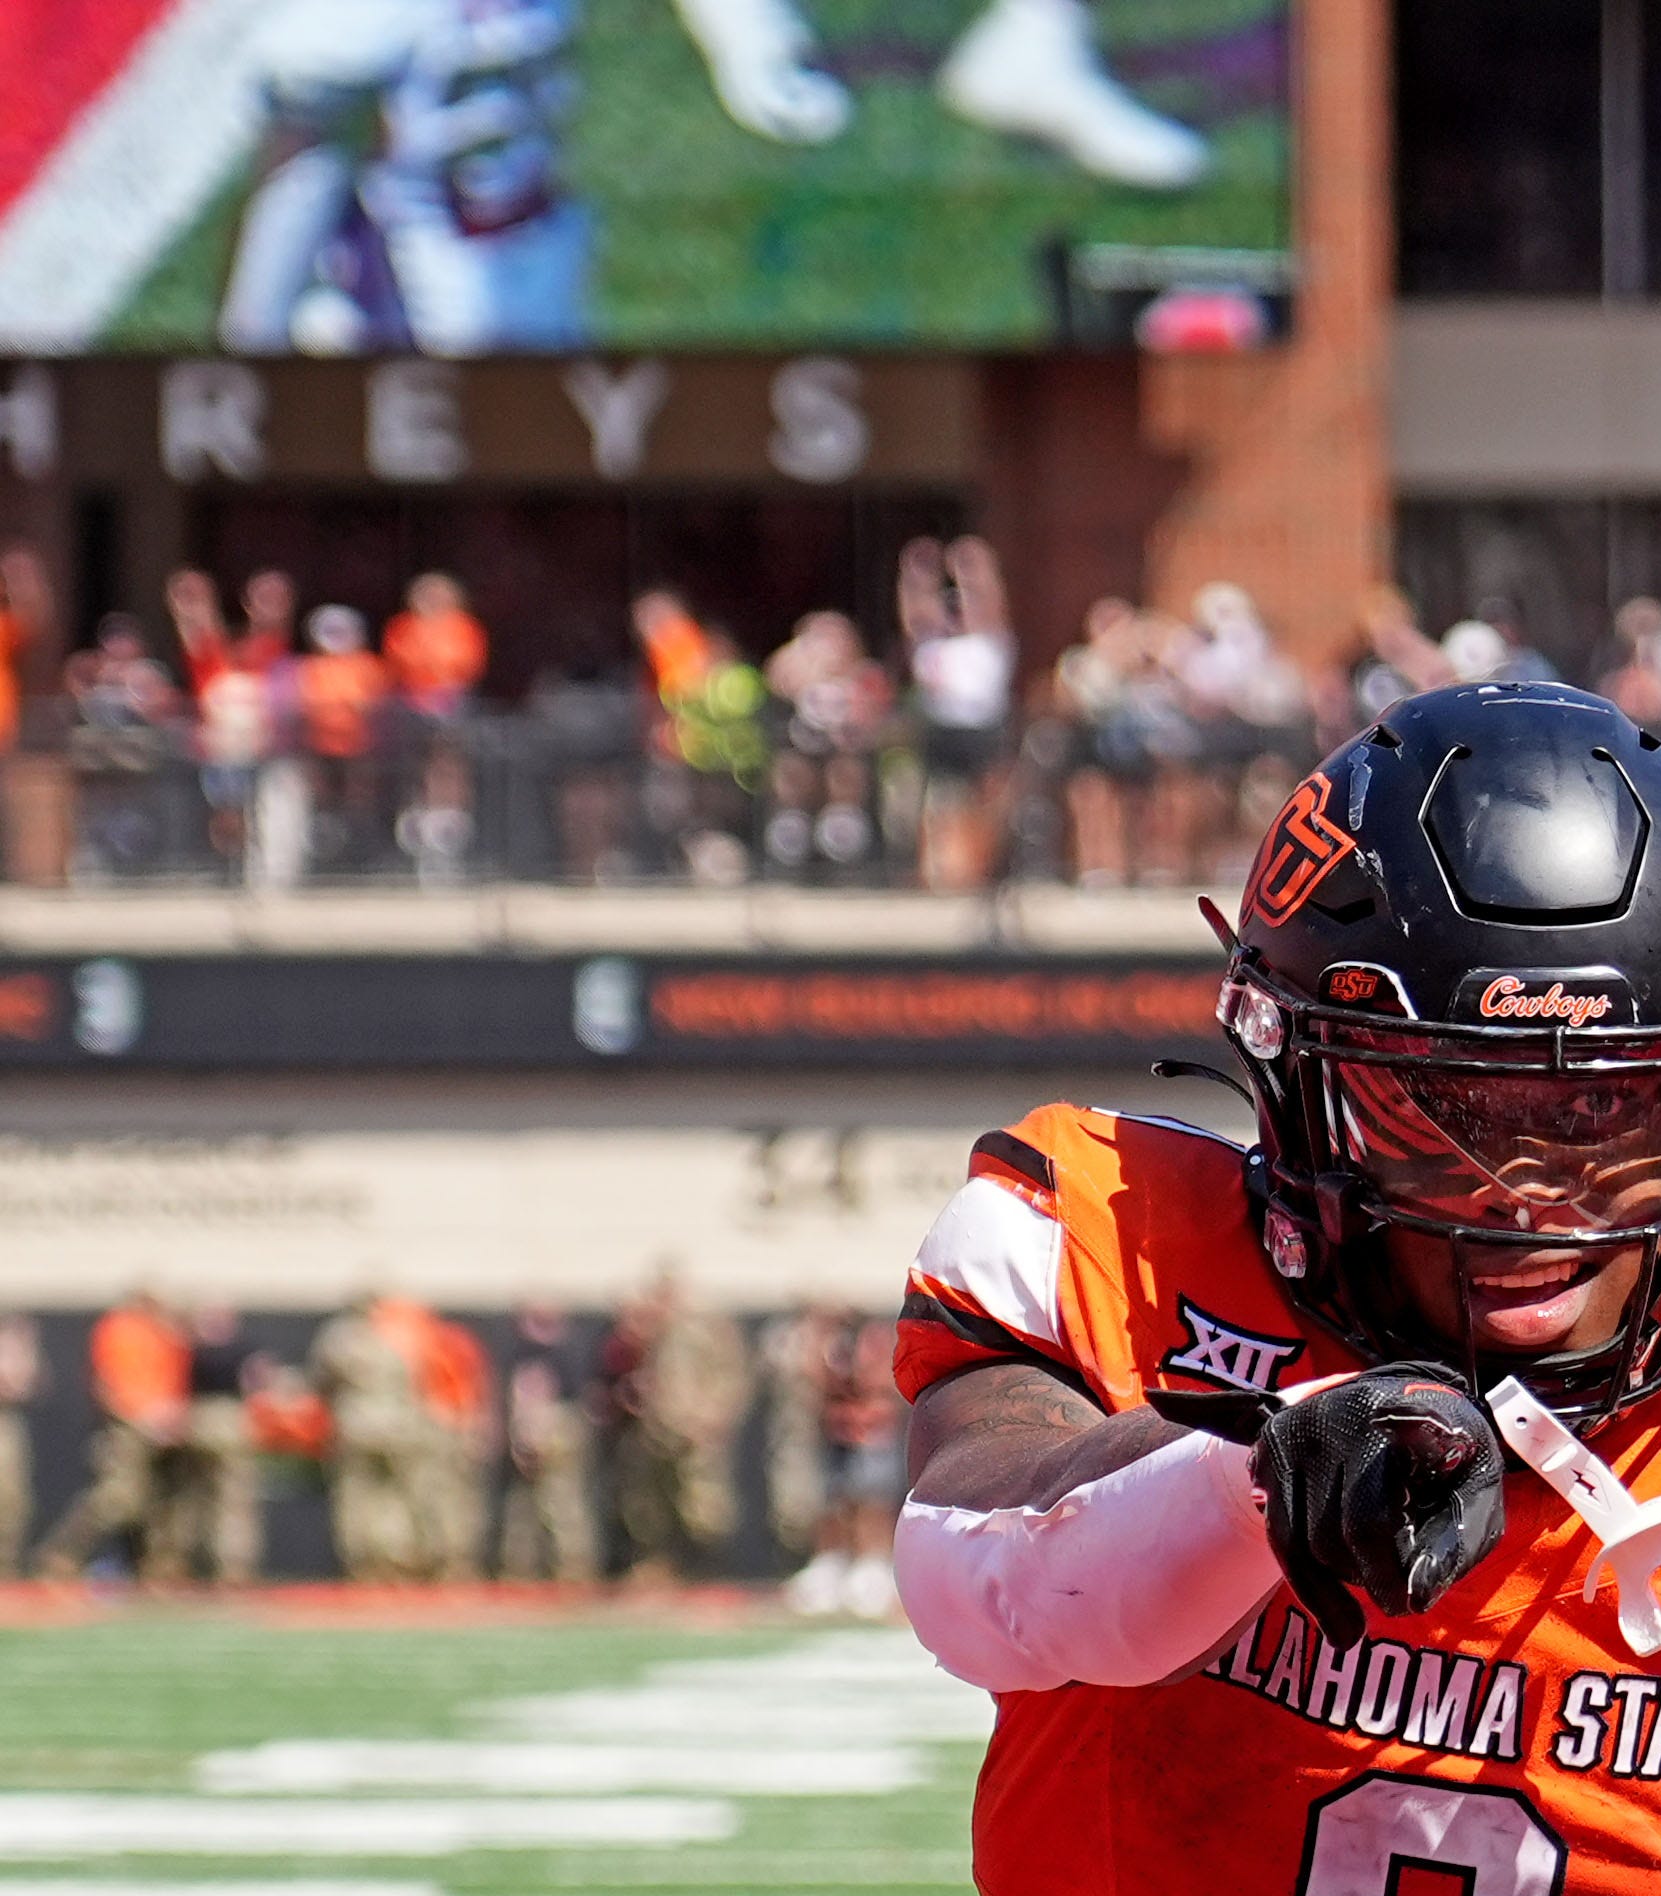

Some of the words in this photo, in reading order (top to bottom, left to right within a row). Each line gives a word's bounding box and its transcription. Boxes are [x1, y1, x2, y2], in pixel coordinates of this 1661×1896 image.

[1329, 968, 1379, 1001] OSU
[1479, 975, 1613, 1027] Cowboys
[1202, 1606, 1526, 1760] LAHOMA
